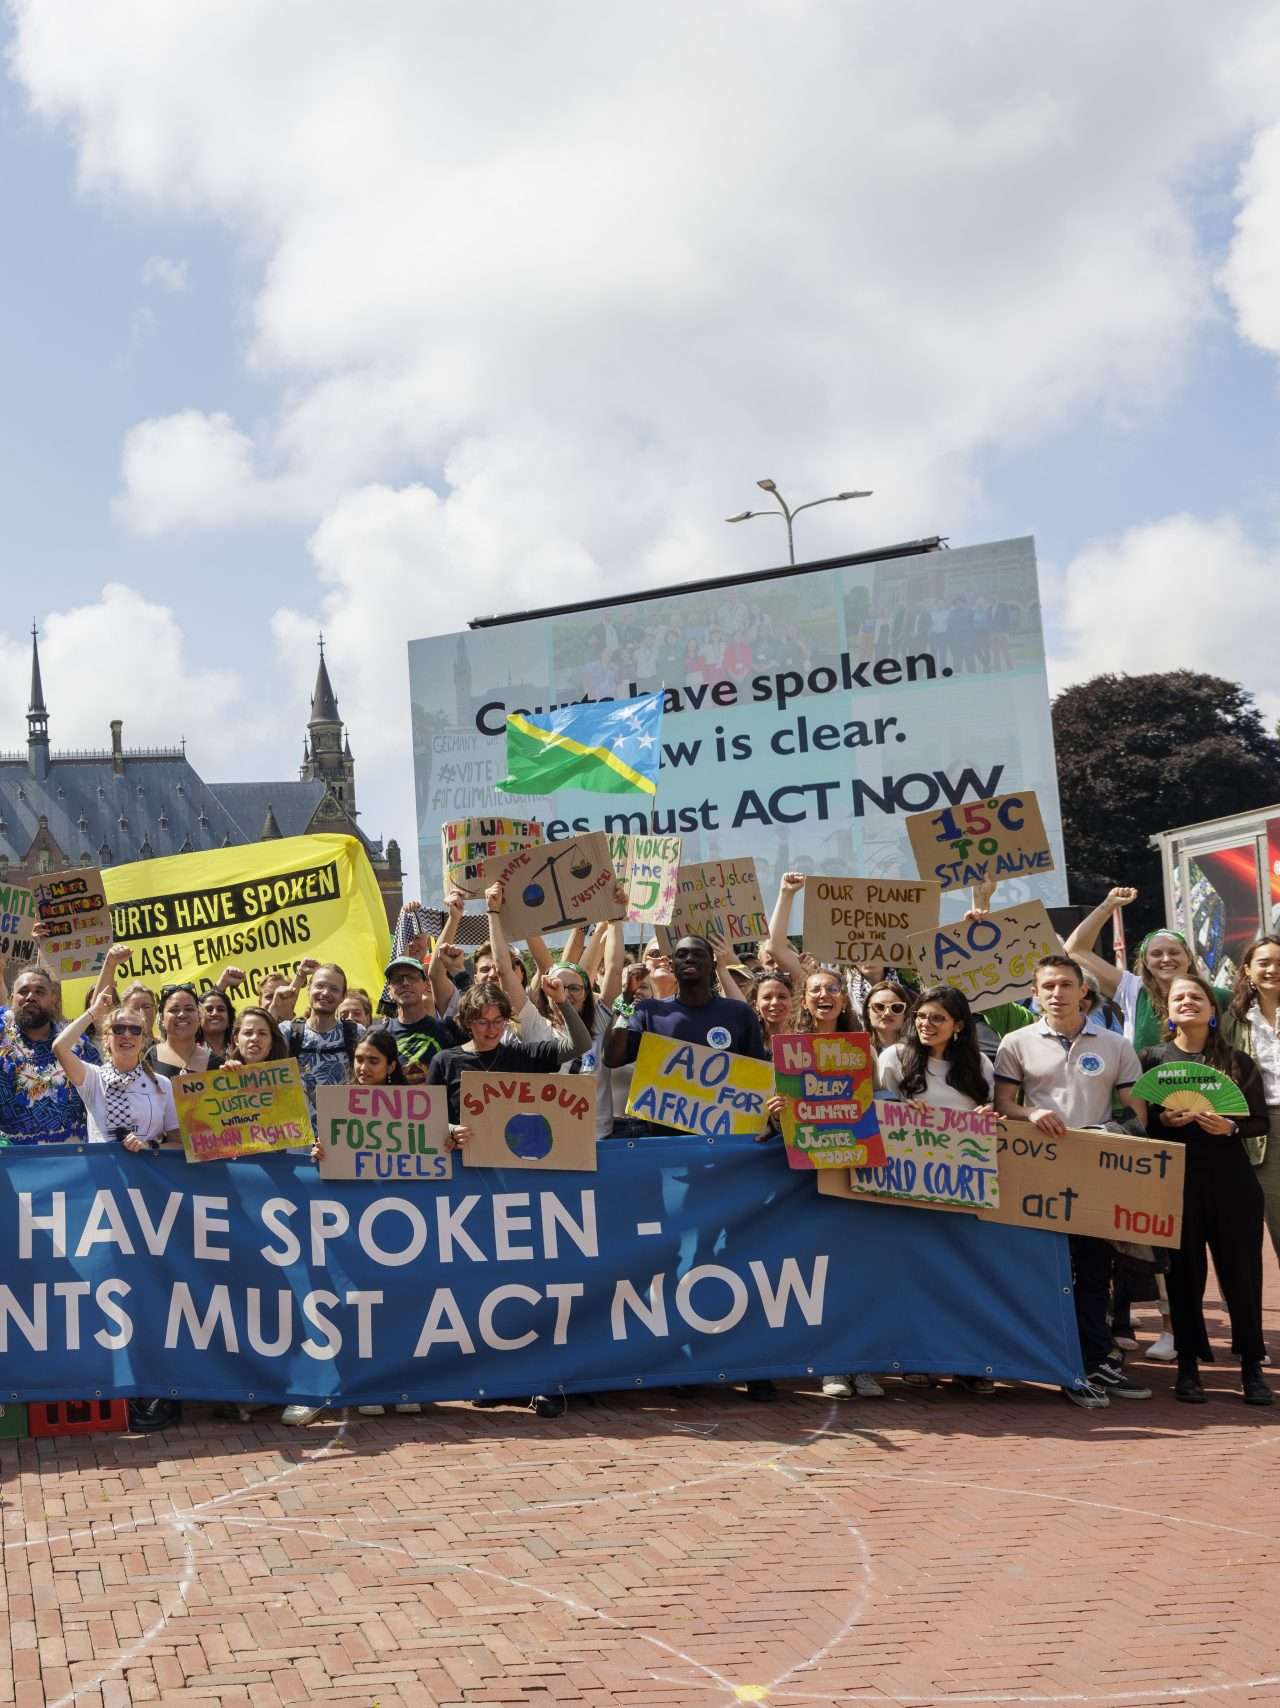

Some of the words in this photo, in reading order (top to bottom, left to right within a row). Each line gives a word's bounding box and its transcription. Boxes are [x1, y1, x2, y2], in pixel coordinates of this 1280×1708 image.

[629, 681, 738, 714] ave
[752, 651, 954, 711] spoken.
[715, 725, 753, 763] is
[770, 715, 907, 756] clear.
[605, 797, 719, 836] must
[731, 780, 841, 828] ACT
[851, 764, 1005, 818] NOW
[950, 837, 998, 861] TO
[632, 863, 662, 879] the
[934, 861, 990, 889] STAY
[174, 891, 236, 929] HAVE
[241, 865, 337, 916] SPOKEN
[688, 888, 736, 918] protect
[816, 882, 854, 902] OUR
[867, 883, 928, 904] PLANET
[726, 911, 770, 938] RIGHTS
[831, 907, 910, 929] DEPENDS
[117, 943, 182, 979] SLASH
[194, 913, 311, 966] EMISSIONS
[847, 930, 865, 942] ON
[869, 930, 887, 941] THE
[933, 920, 1003, 970] AO
[834, 940, 913, 966] ICJAO!
[182, 1079, 205, 1094] NO
[212, 1066, 294, 1092] CLIMATE
[664, 1045, 732, 1087] AO
[1157, 1069, 1187, 1078] MAKE
[1158, 1075, 1217, 1086] POLLUTERS
[1199, 1082, 1223, 1091] PAY
[348, 1088, 432, 1120] END
[463, 1079, 533, 1117] SAVE
[540, 1082, 591, 1121] OUR
[634, 1087, 733, 1137] AFRICA
[717, 1086, 766, 1114] FOR
[797, 1102, 859, 1121] CLIMATE
[191, 1127, 242, 1154] HUMAN
[888, 1129, 909, 1142] at
[913, 1128, 951, 1149] the
[355, 1151, 447, 1178] FUELS
[1099, 1150, 1172, 1180] must
[922, 1161, 997, 1202] COURT
[1022, 1187, 1079, 1221] act
[1113, 1203, 1175, 1238] now
[18, 1187, 231, 1262] HAVE
[260, 1188, 600, 1267] SPOKEN
[165, 1281, 383, 1361] MUST
[413, 1282, 584, 1359] ACT
[610, 1254, 830, 1342] NOW
